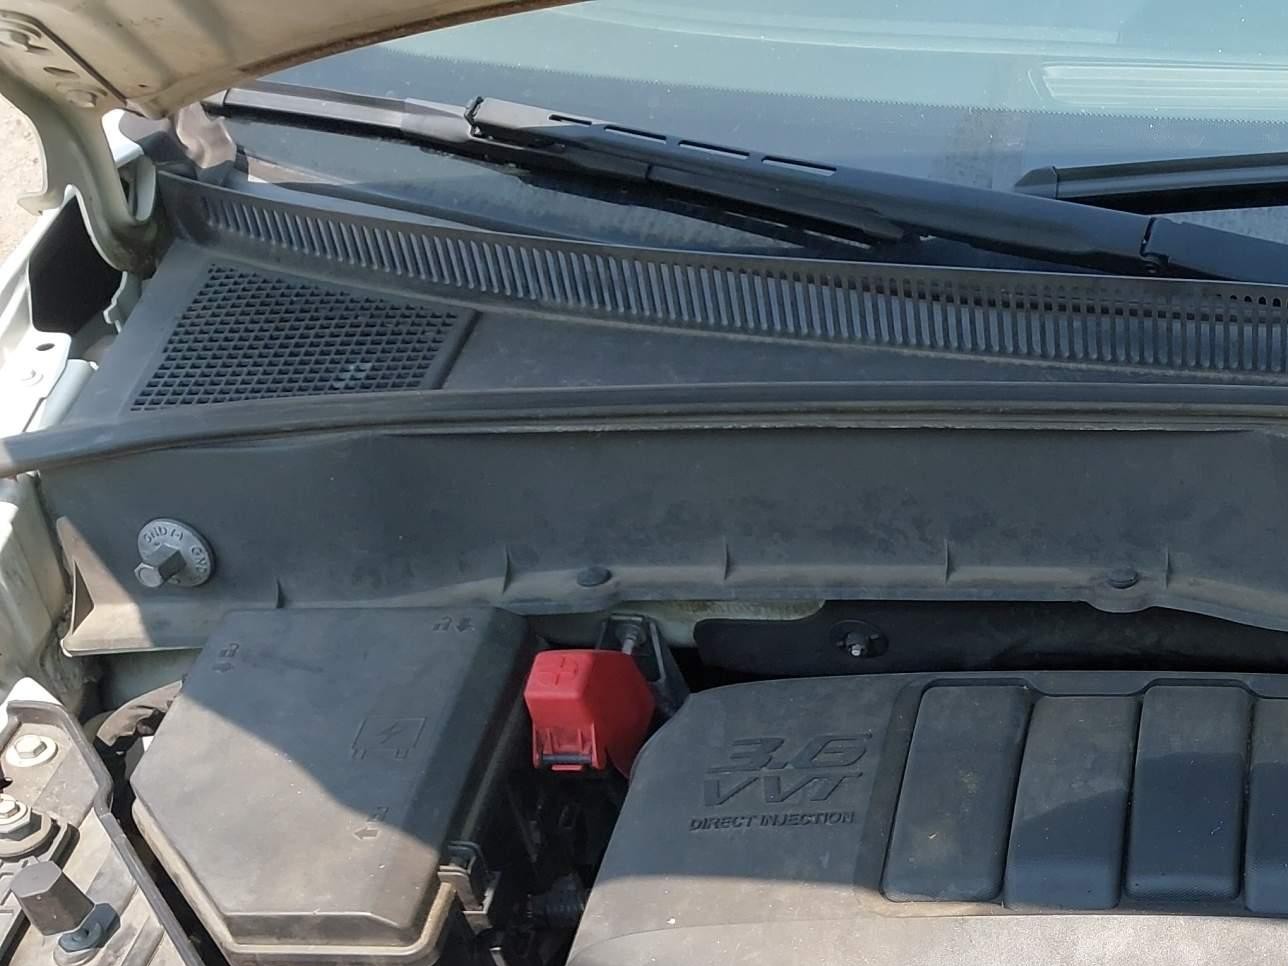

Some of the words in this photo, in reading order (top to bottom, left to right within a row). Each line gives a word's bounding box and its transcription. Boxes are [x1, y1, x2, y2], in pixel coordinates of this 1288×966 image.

[706, 731, 872, 774] 3.6
[689, 815, 754, 832] DIRECT
[759, 811, 856, 828] INJECTION
